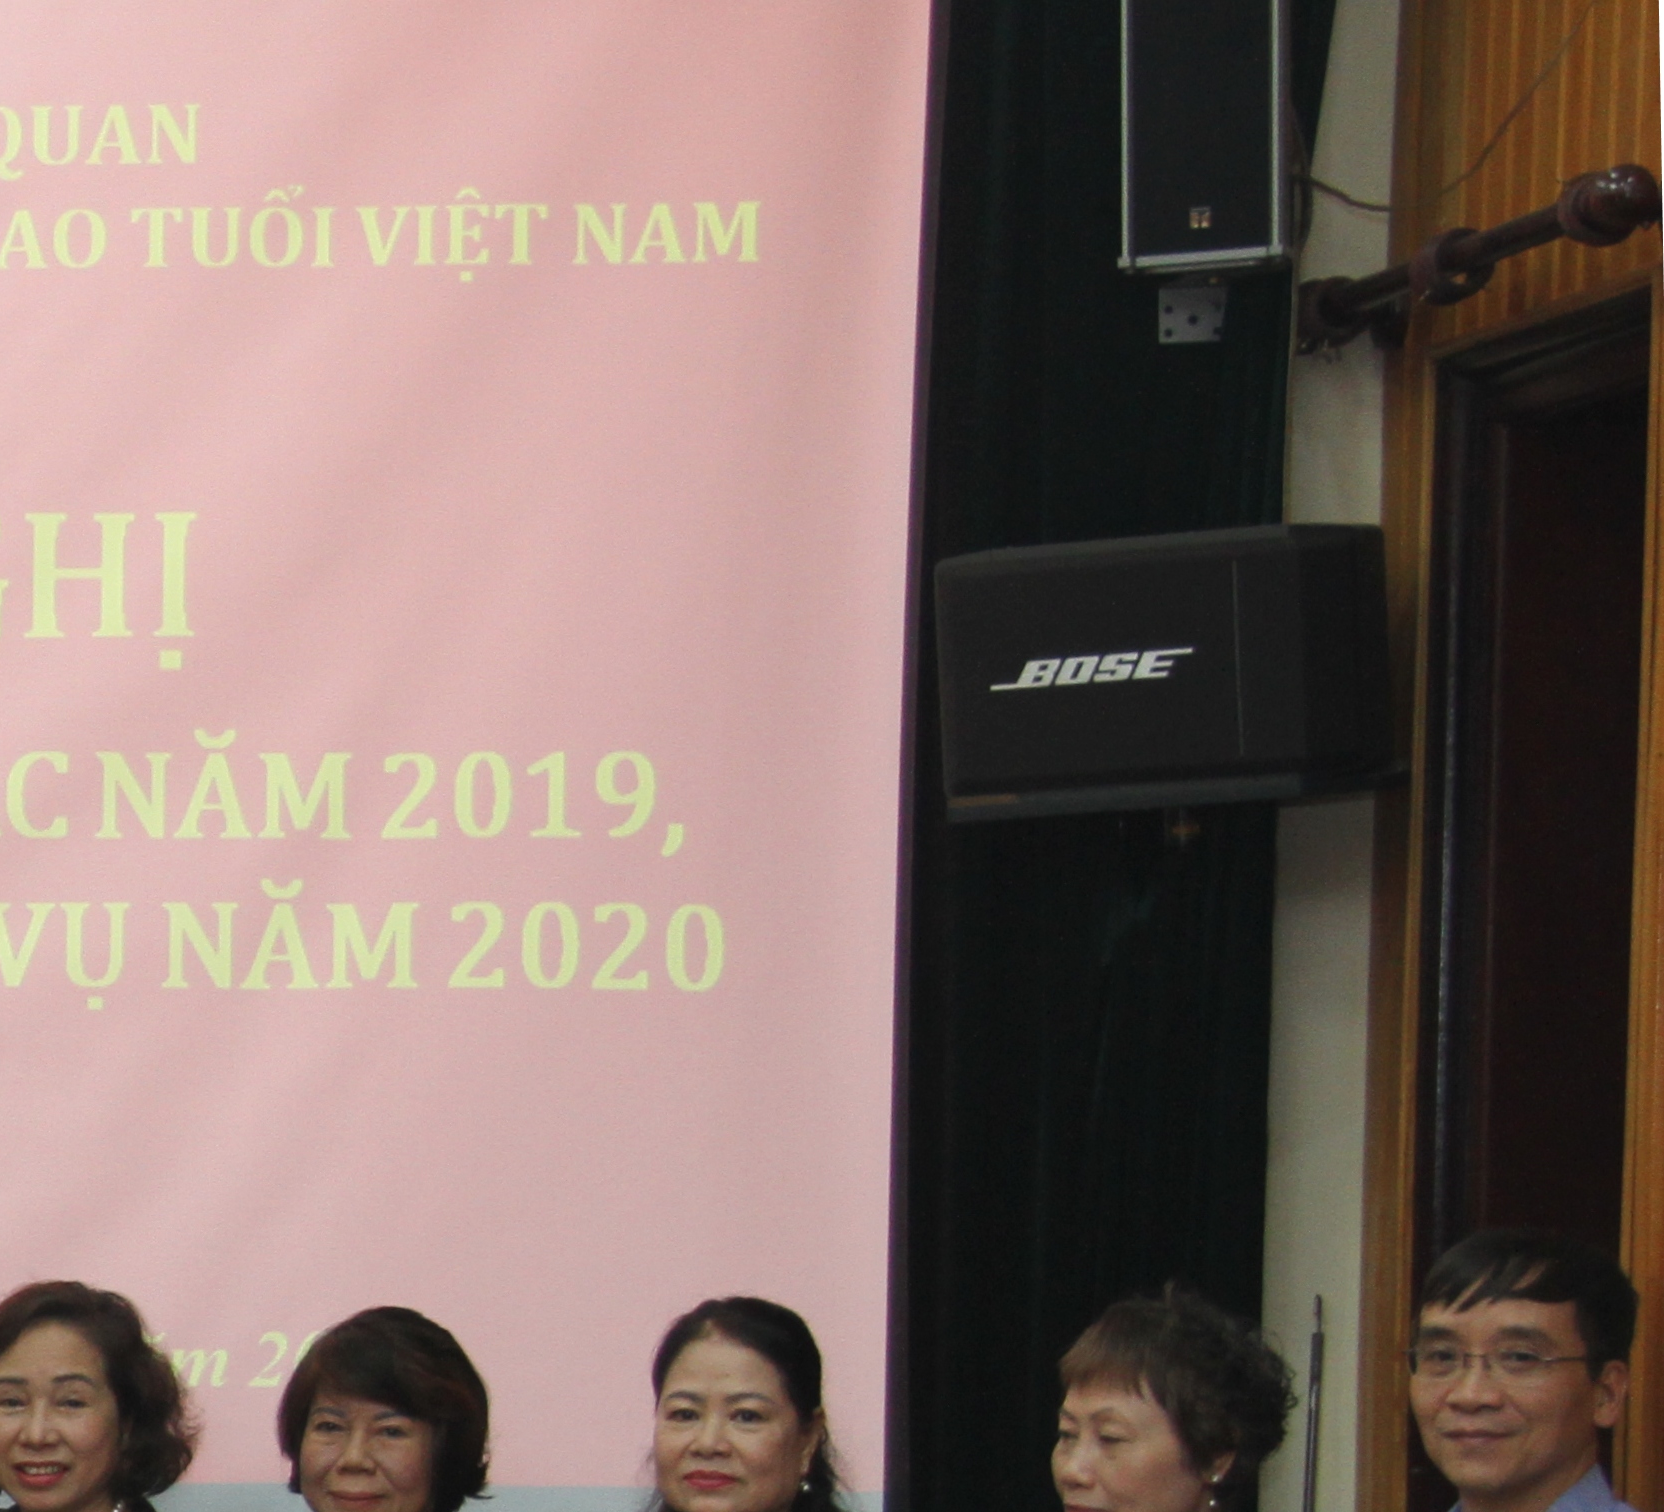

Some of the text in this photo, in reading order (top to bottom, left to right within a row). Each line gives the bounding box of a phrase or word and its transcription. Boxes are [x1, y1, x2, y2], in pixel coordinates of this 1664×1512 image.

[129, 184, 334, 268] TUỔI
[356, 184, 550, 283] VIỆT
[573, 200, 762, 265] NAM
[990, 647, 1193, 691] BOSE
[96, 726, 352, 842] NĂM
[379, 750, 687, 858] 2019,
[161, 876, 421, 992] NĂM
[446, 900, 727, 993] 2020
